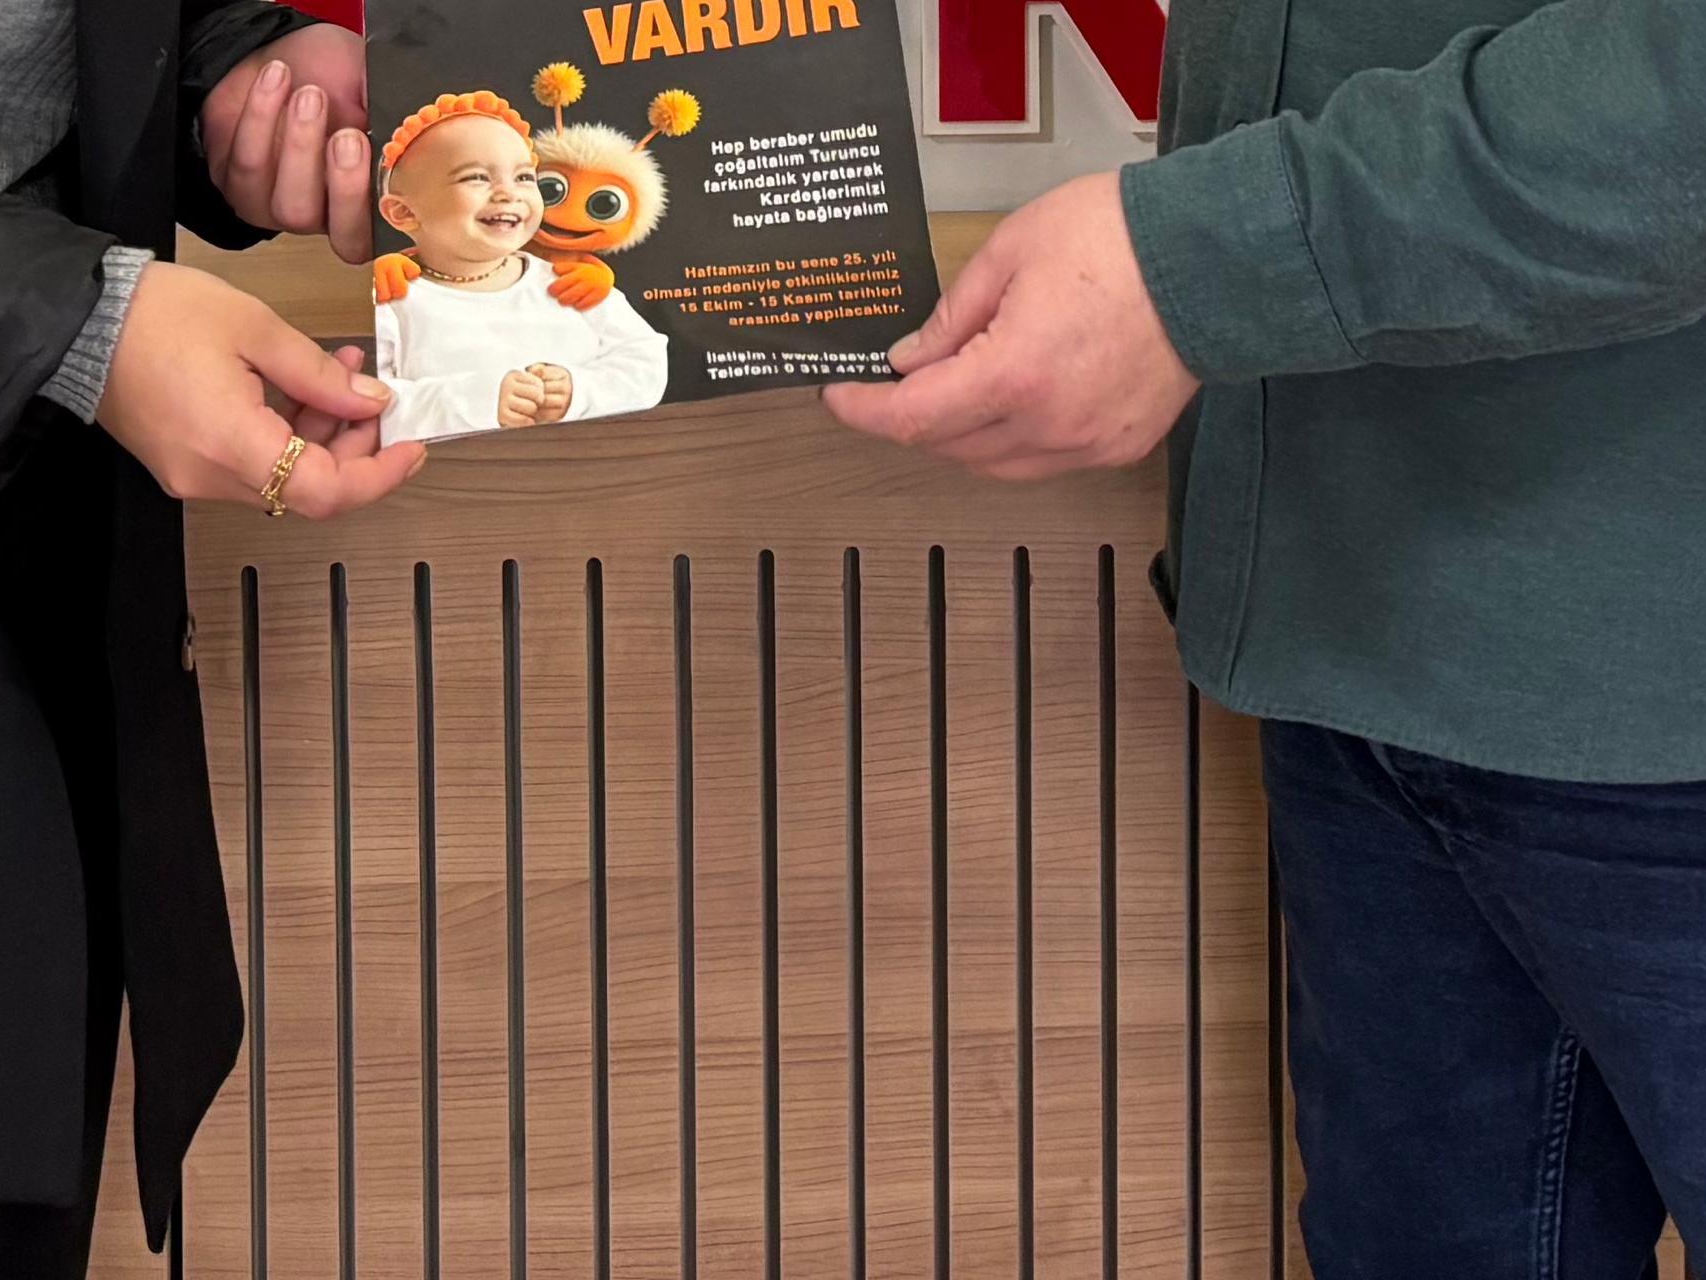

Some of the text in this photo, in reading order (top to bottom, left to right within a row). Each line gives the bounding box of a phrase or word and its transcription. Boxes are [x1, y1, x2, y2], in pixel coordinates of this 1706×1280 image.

[711, 123, 878, 156] Hep beraber umudu
[714, 143, 881, 176] çoğaltalım Turuncu
[704, 162, 884, 193] farkındalık yaratarak
[760, 180, 886, 207] Kardeşlerimizi
[733, 201, 889, 229] hayata bağlayalım
[684, 249, 896, 279] Haftamızın bu sene 25. yılı
[643, 267, 899, 301] olması nedeniyle etkinliklerimiz
[703, 299, 743, 312] Ekim
[759, 296, 778, 309] 15
[783, 290, 833, 306] Kasım
[838, 284, 903, 302] tarihleri
[728, 312, 800, 326] arasında
